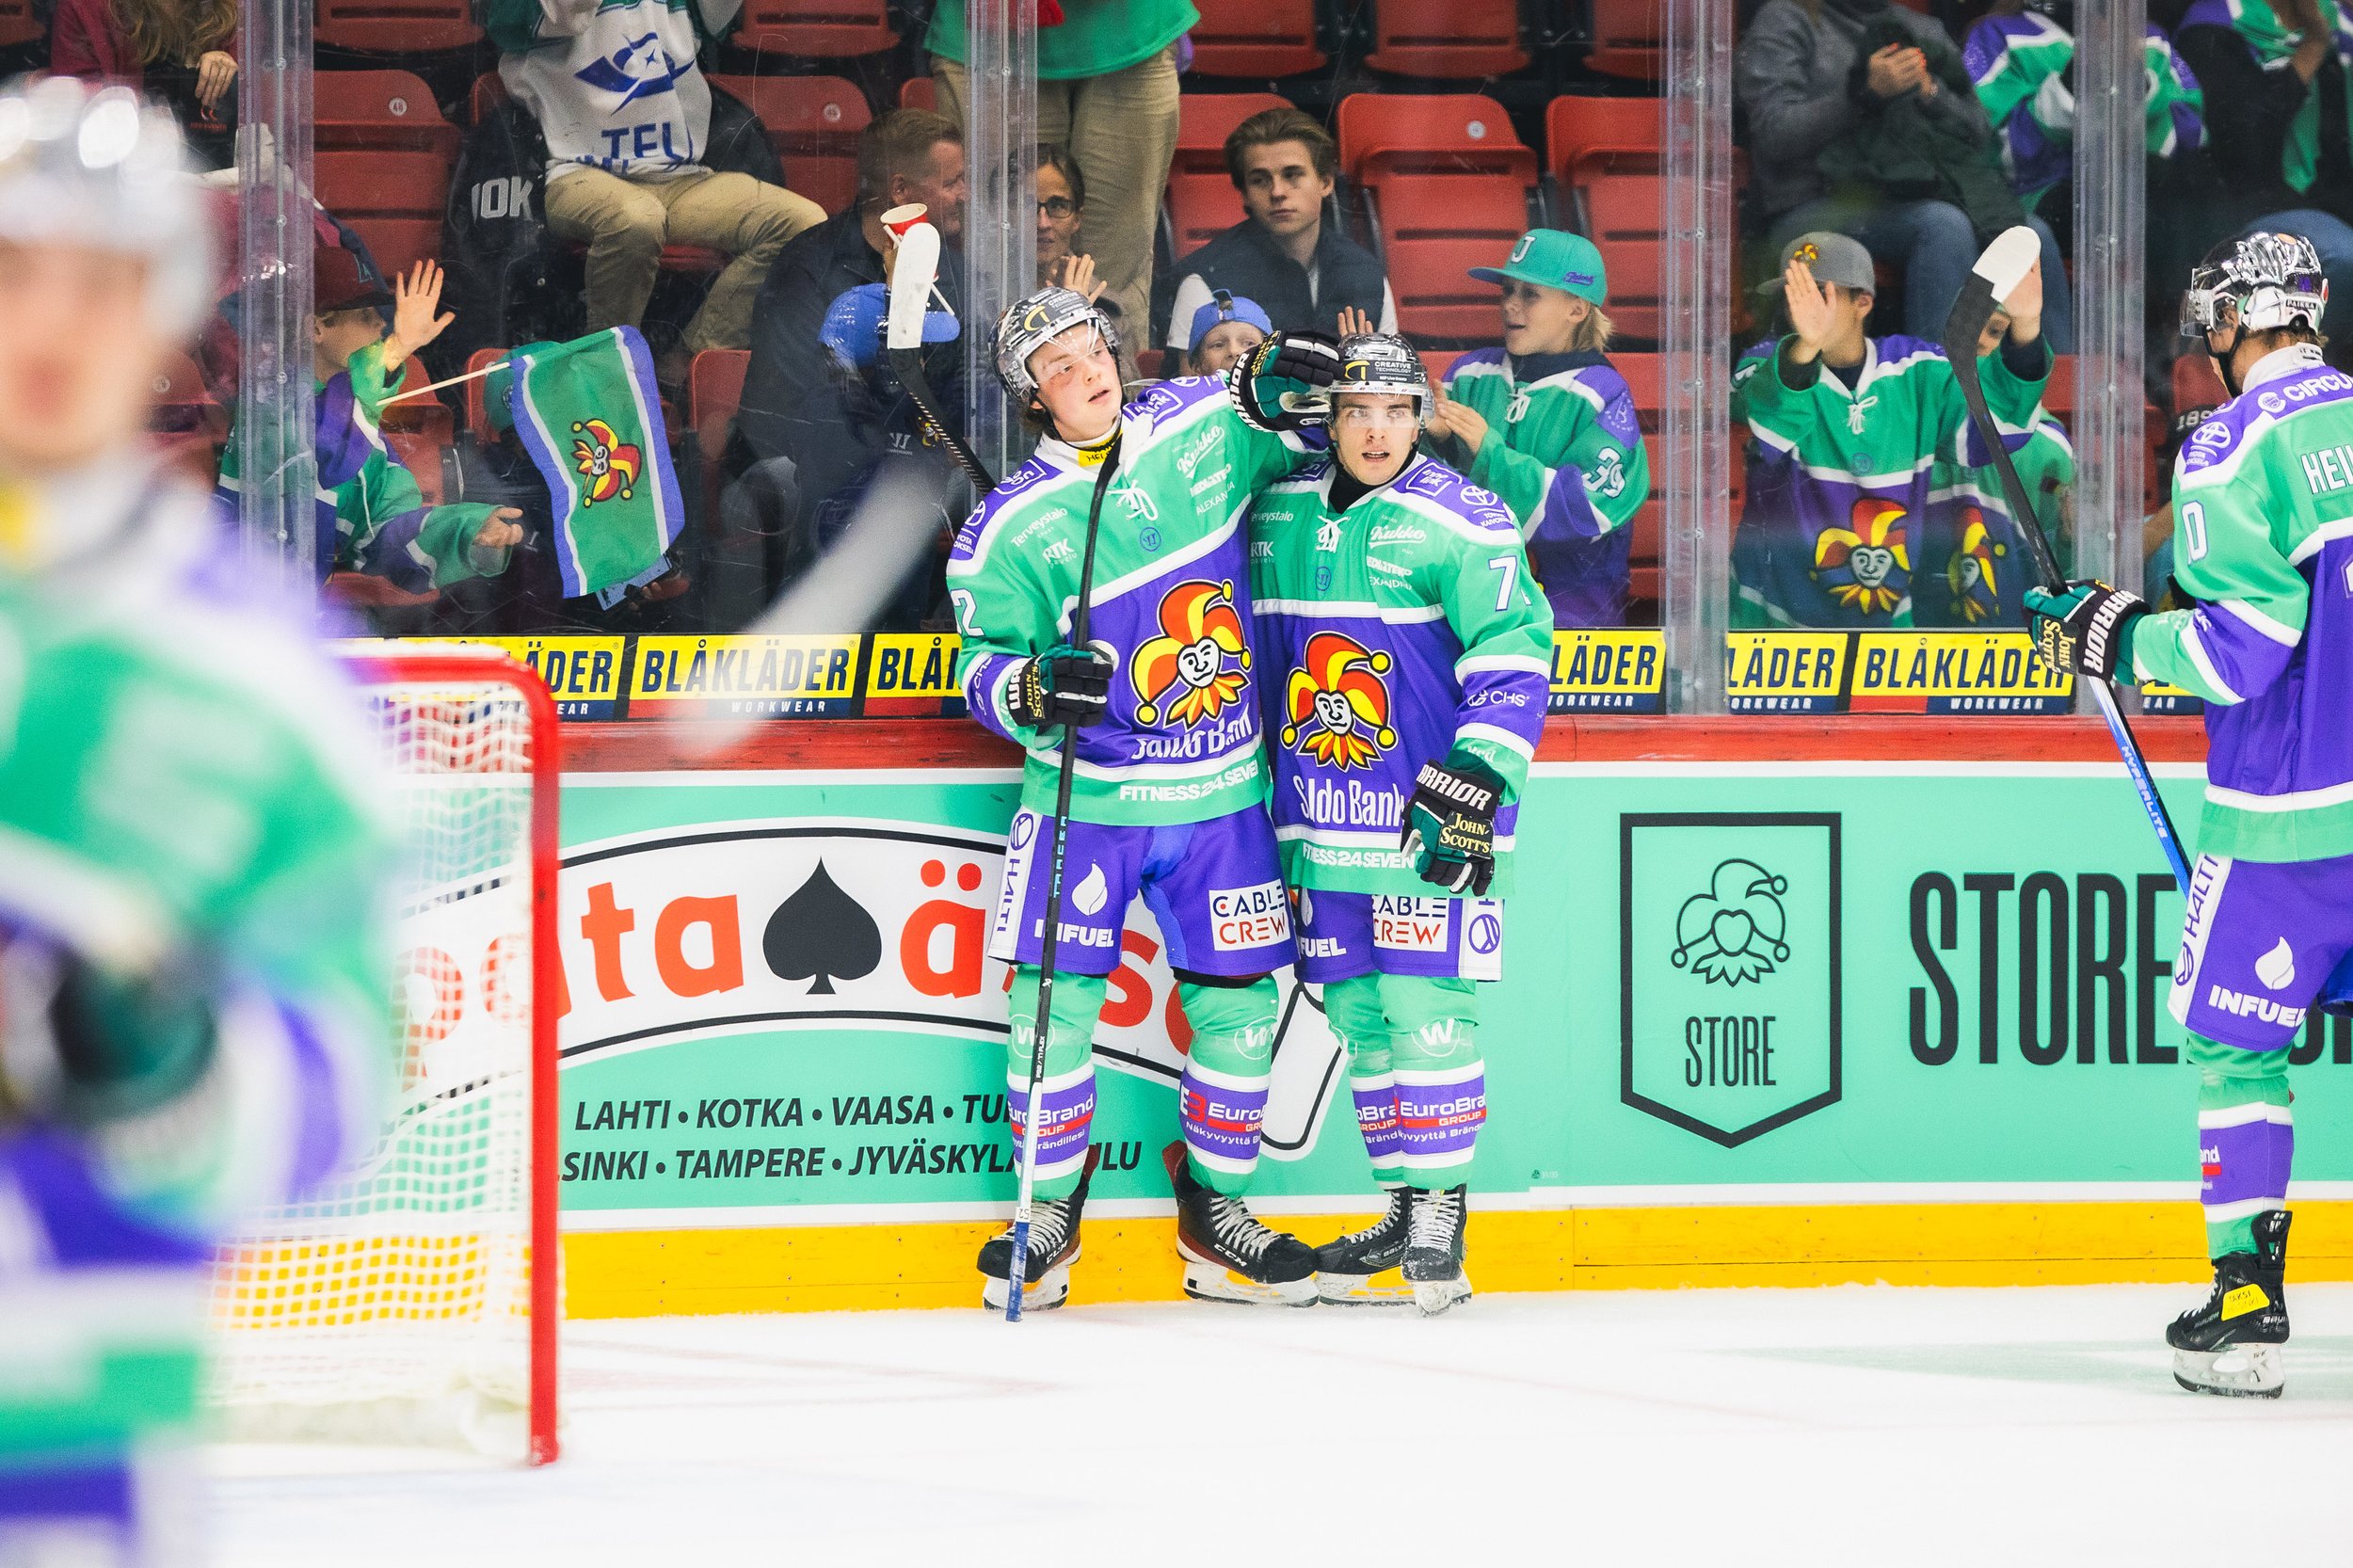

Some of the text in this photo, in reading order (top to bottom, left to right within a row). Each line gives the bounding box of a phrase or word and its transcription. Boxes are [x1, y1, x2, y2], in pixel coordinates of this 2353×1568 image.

[1511, 236, 1534, 264] J
[1374, 360, 1412, 370] CREATIVE
[1229, 352, 1276, 433] ARRIOR
[2282, 373, 2353, 402] CIRCU
[1176, 424, 1225, 474] Kukko
[1010, 507, 1068, 548] Terveystalo
[1251, 510, 1294, 523] erveystalo
[1369, 524, 1427, 542] Kukko
[1042, 537, 1076, 565] RTK
[1250, 541, 1275, 557] RTK
[1489, 555, 1531, 612] 7
[950, 588, 985, 637] 2
[2083, 589, 2142, 674] ARRIOR
[642, 638, 850, 694] BLÅKLÄDER
[1549, 635, 1657, 686] LÄDER
[731, 702, 825, 714] WORKWEAR
[1031, 665, 1043, 718] SCOTT'S
[1490, 690, 1528, 708] CHS
[1950, 696, 2044, 710] WORKWEAR
[1120, 759, 1258, 802] FITNESS24SEVE
[1440, 826, 1491, 853] SCOTT'S
[1452, 812, 1488, 837] JOHN
[1053, 815, 1068, 899] TRACER
[997, 857, 1021, 933] HALTI
[1212, 884, 1286, 919] CABLE
[2184, 853, 2219, 939] HALTI
[1218, 911, 1288, 946] CREW
[1910, 870, 2180, 1066] STORE
[1685, 1016, 1777, 1088] STORE
[575, 1099, 671, 1130] LAHTI
[696, 1098, 804, 1128] KOTKA
[831, 1096, 935, 1126] VAASA
[1208, 1101, 1264, 1121] Euro
[1438, 1111, 1482, 1128] GROUP
[1022, 1125, 1066, 1137] GOUP
[1036, 1128, 1085, 1151] rändillesi
[1186, 1120, 1251, 1145] Näkyvyyttä
[557, 1150, 649, 1182] SINKI
[676, 1147, 826, 1179] TAMPERE
[1222, 1243, 1248, 1268] CCM
